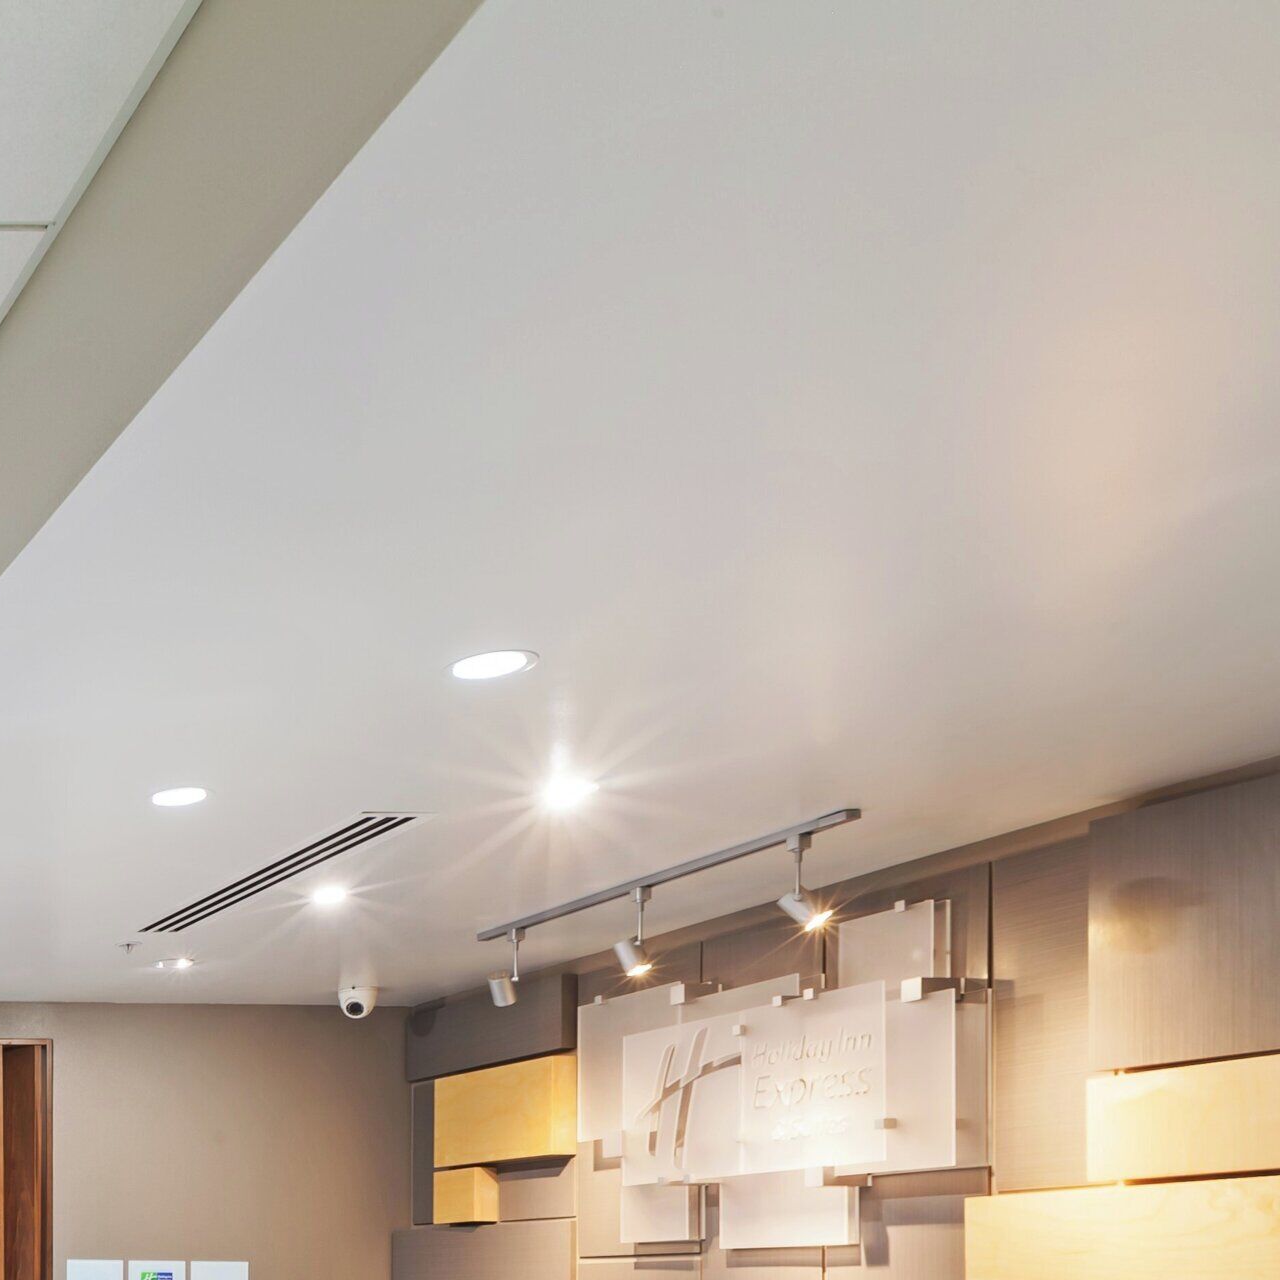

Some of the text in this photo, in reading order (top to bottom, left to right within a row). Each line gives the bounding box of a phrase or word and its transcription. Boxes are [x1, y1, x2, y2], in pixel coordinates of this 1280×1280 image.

[752, 1026, 873, 1067] Holiday Inn
[752, 1065, 874, 1111] Express
